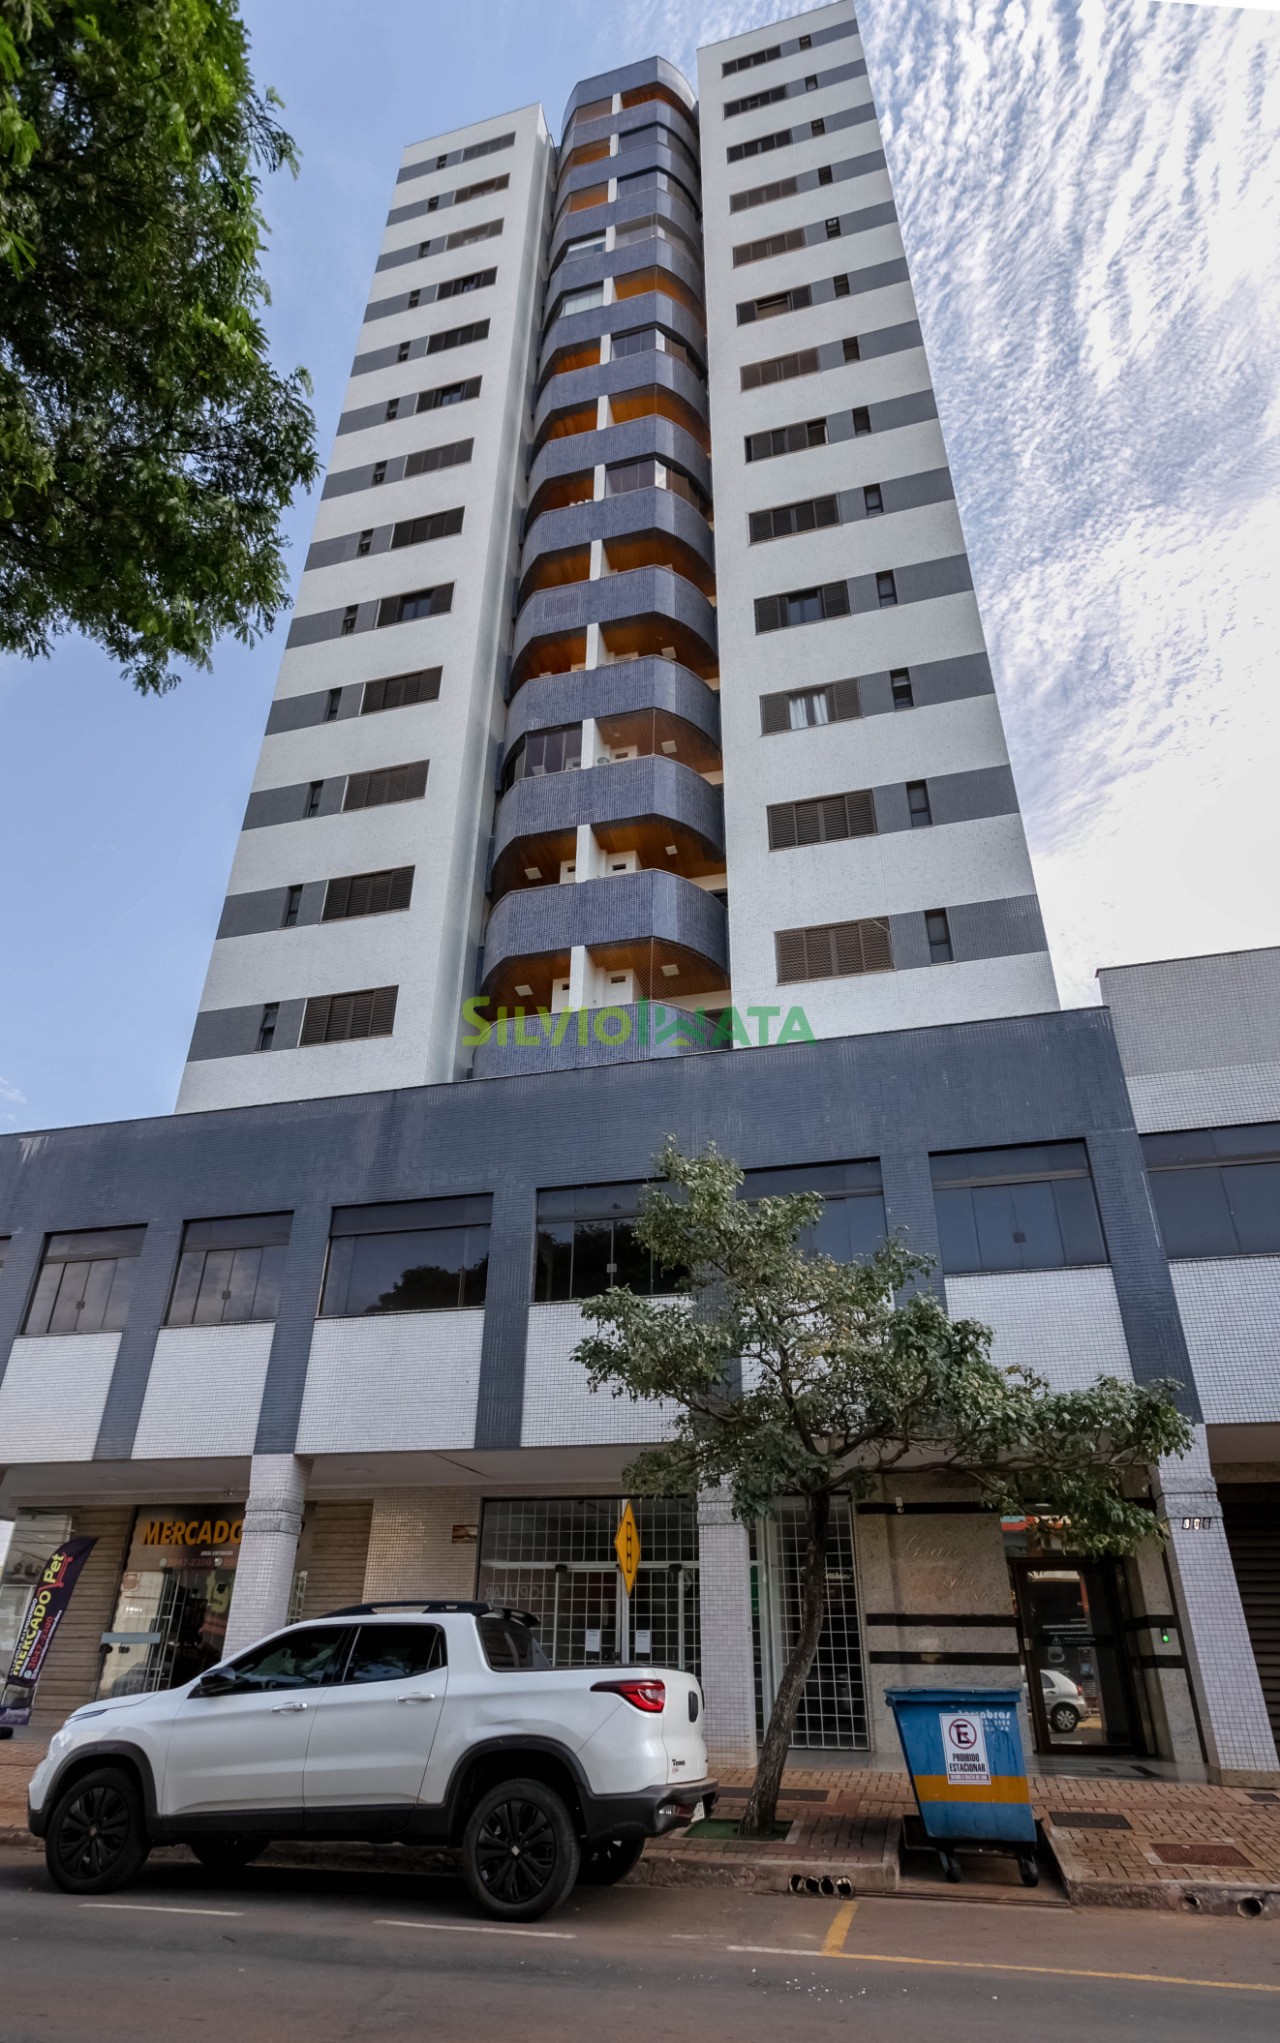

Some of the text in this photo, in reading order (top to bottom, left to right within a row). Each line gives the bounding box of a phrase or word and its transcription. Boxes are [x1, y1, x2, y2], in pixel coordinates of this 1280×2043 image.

[143, 1519, 243, 1546] MERCADO
[12, 1590, 52, 1676] MERCADO
[43, 1553, 65, 1584] Pet
[955, 1724, 970, 1744] E
[952, 1753, 980, 1762] PROIBIDO
[949, 1763, 987, 1773] ESTACIONAR
